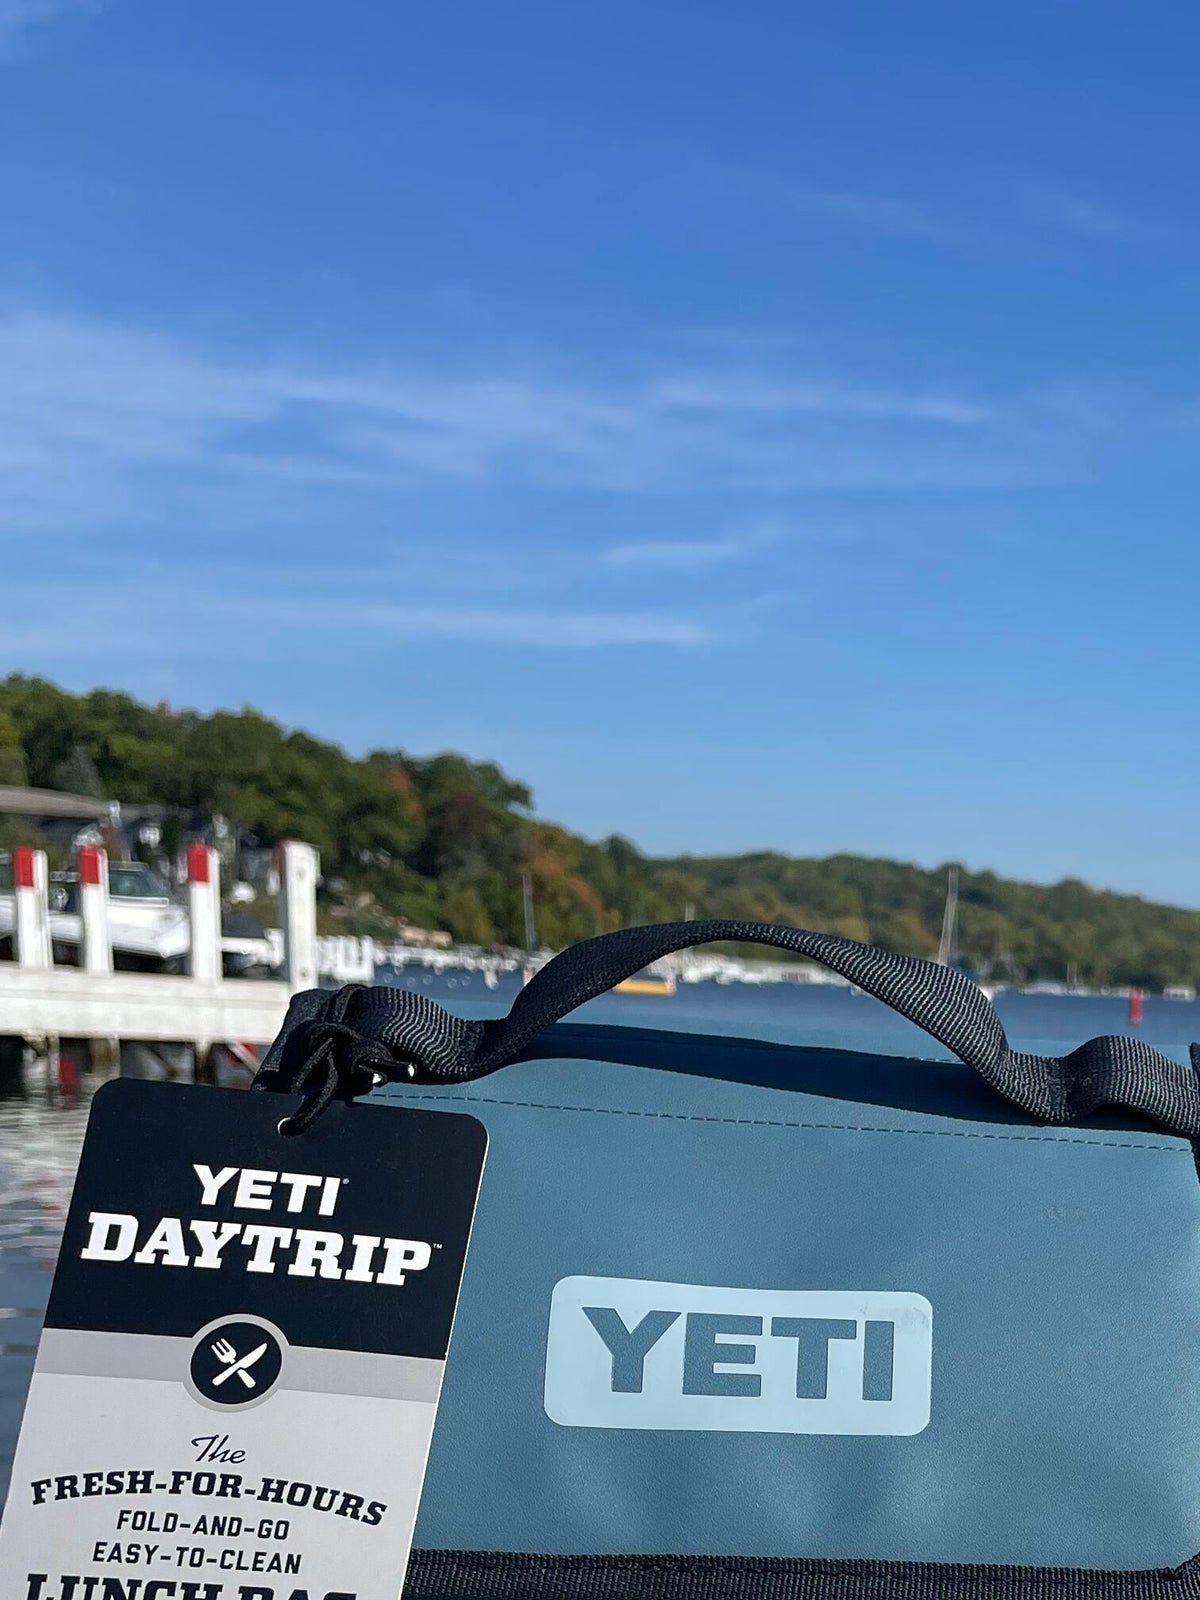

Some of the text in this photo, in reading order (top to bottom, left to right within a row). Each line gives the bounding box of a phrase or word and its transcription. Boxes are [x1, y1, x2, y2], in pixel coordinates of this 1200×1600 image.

[582, 1306, 895, 1401] YETI
[191, 1434, 246, 1464] The
[30, 1470, 388, 1526] FRESH-FOR-HOURS
[116, 1510, 290, 1540] FOLD-AND-GO
[92, 1542, 302, 1574] EASY-TO-CLEAN
